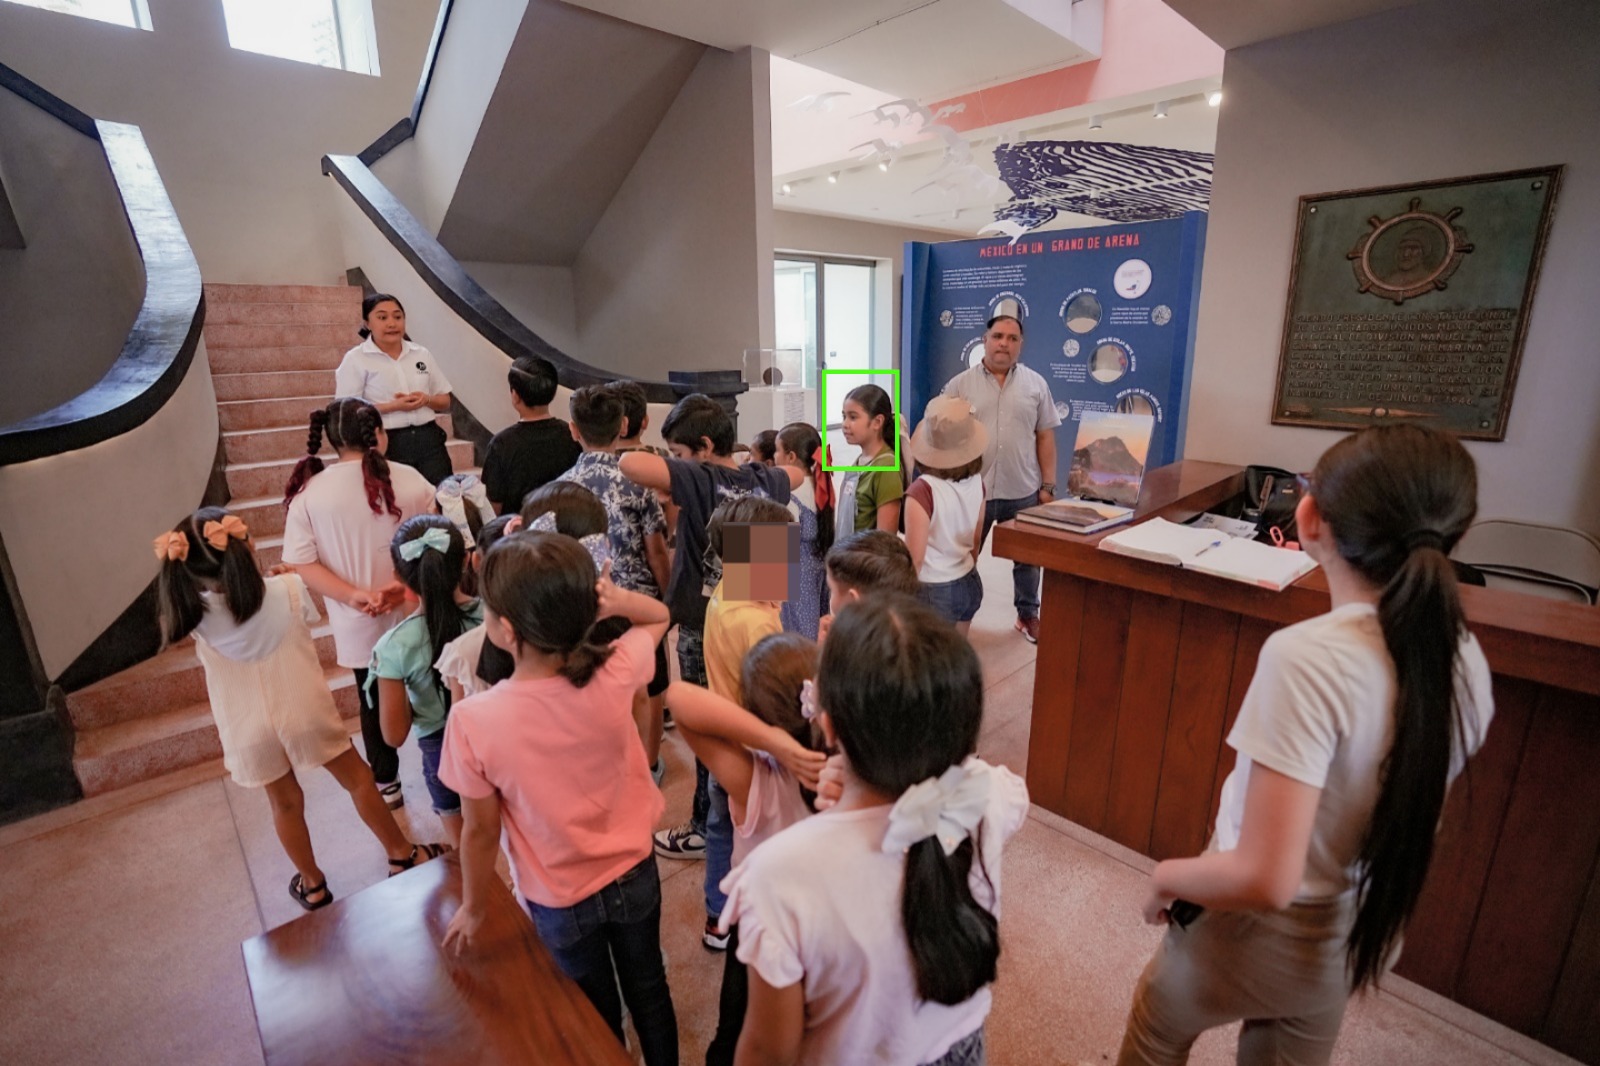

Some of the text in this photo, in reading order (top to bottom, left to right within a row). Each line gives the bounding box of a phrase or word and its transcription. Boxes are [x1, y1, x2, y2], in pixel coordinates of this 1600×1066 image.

[1016, 243, 1028, 254] EN
[1032, 242, 1042, 254] UN
[1052, 238, 1083, 252] GRANO
[1088, 236, 1100, 250] DE
[1105, 234, 1139, 248] ARENA
[1390, 322, 1432, 332] UNIDOS
[1420, 331, 1466, 342] MANUEL
[1420, 342, 1434, 352] DE
[1438, 342, 1482, 353] MARINA
[1290, 361, 1328, 370] CORONA
